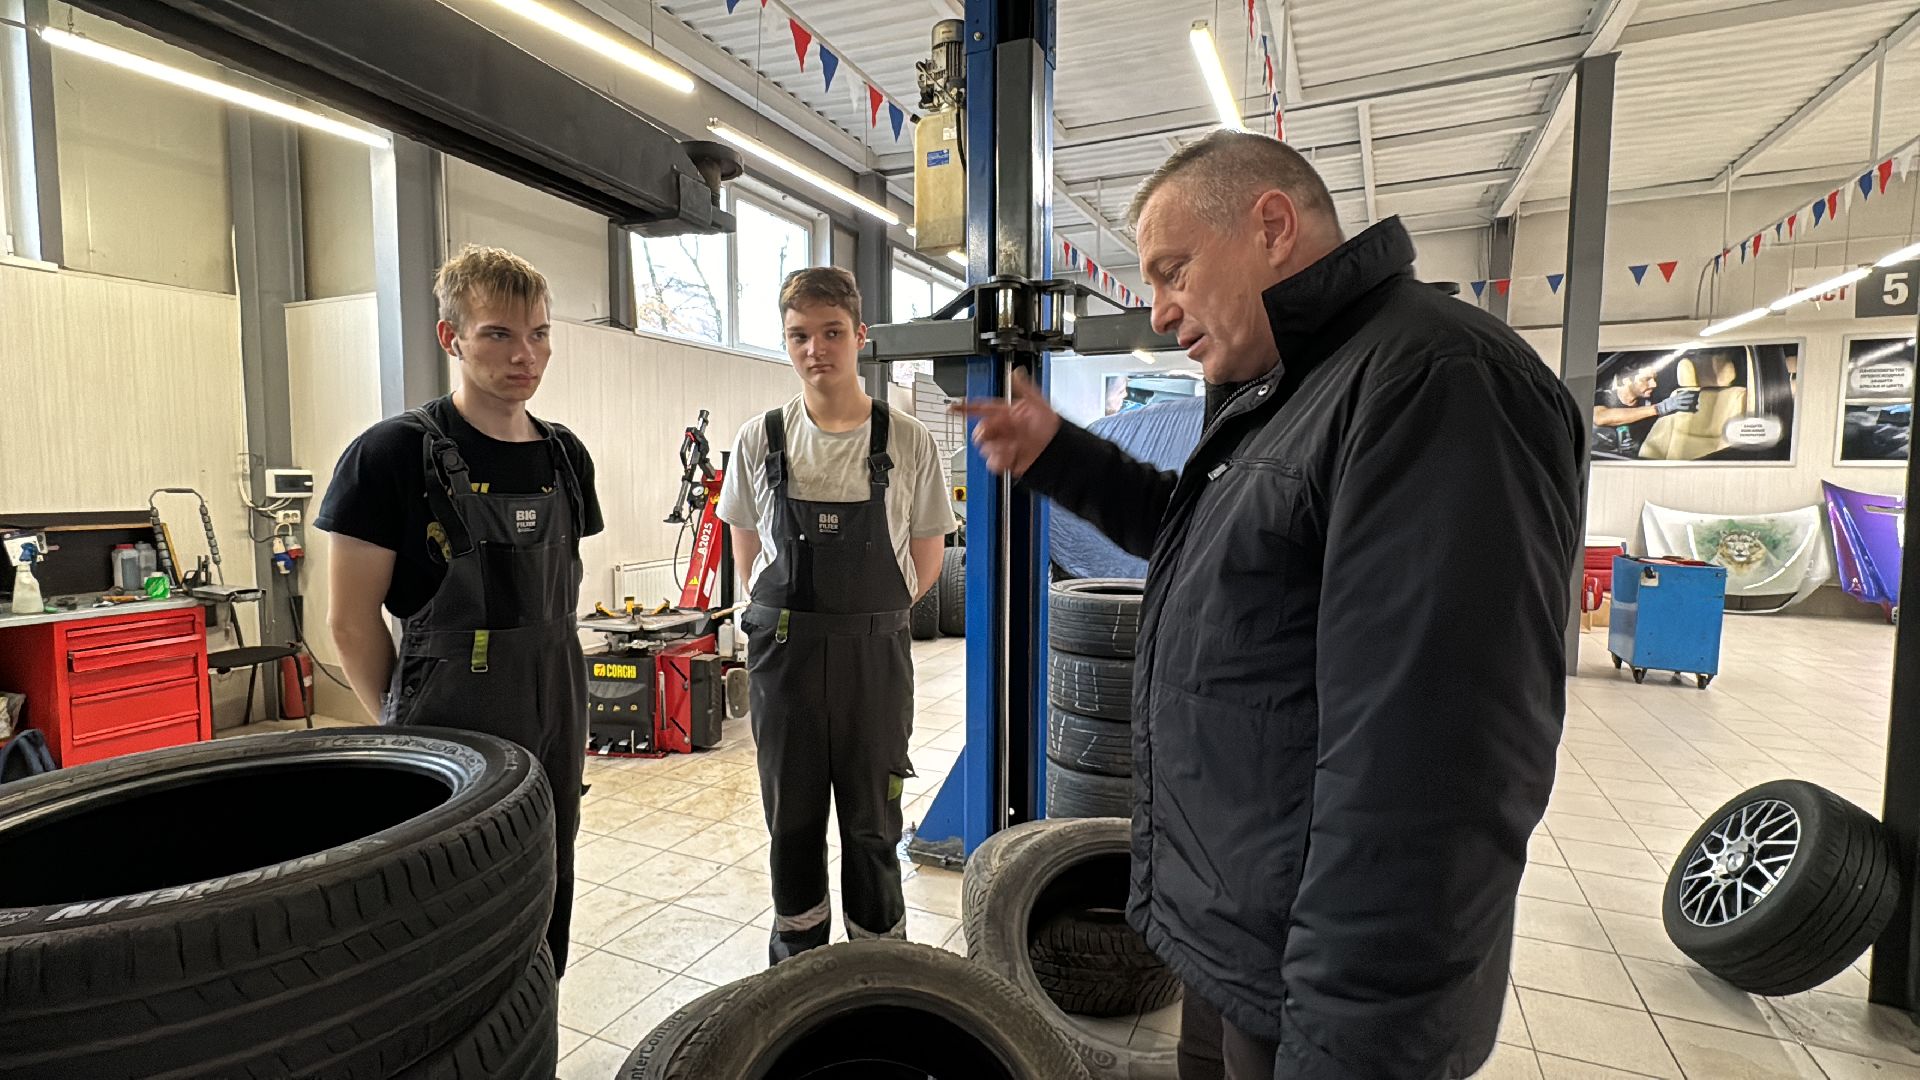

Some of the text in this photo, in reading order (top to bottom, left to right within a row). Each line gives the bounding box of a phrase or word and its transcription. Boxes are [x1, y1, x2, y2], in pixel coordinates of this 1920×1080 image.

[1882, 272, 1909, 305] 5
[515, 509, 537, 521] BIG
[818, 513, 839, 524] BIG
[697, 522, 713, 557] A2025
